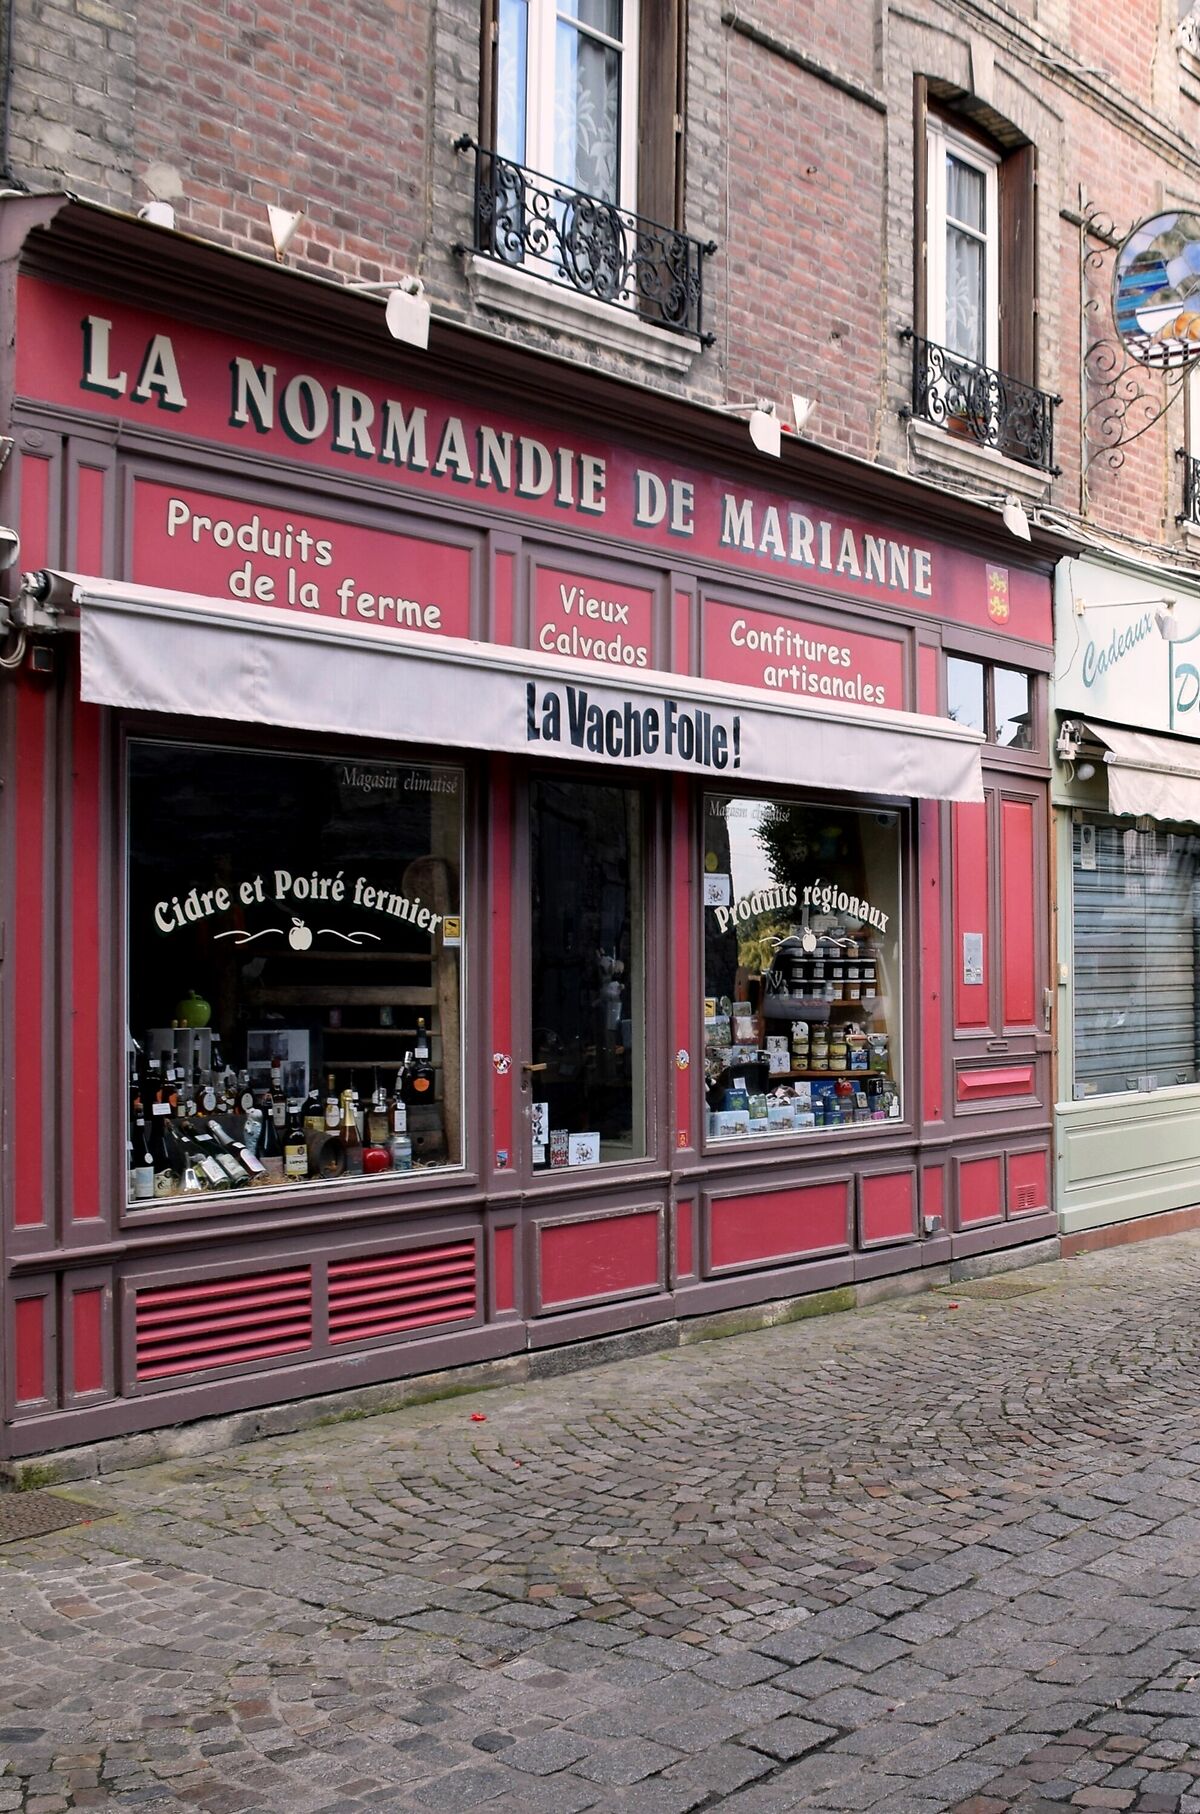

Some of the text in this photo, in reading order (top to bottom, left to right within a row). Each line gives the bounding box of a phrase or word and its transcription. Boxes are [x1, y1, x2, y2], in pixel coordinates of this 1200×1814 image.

[84, 314, 932, 597] LA NORMANDIE DE MARIANNE
[167, 498, 333, 566] Produits
[228, 560, 442, 629] de la ferme
[559, 584, 629, 625] Vieux
[539, 623, 648, 667] Calvados
[730, 620, 851, 667] Confitures
[1082, 613, 1152, 688] Cadeaux
[763, 664, 885, 705] artisanales
[526, 681, 561, 741] La
[565, 685, 660, 757] Vache
[341, 767, 459, 793] Magasin climatisé
[154, 870, 442, 934] Cidre et Poiré fermier
[714, 878, 890, 933] Produits régionaux
